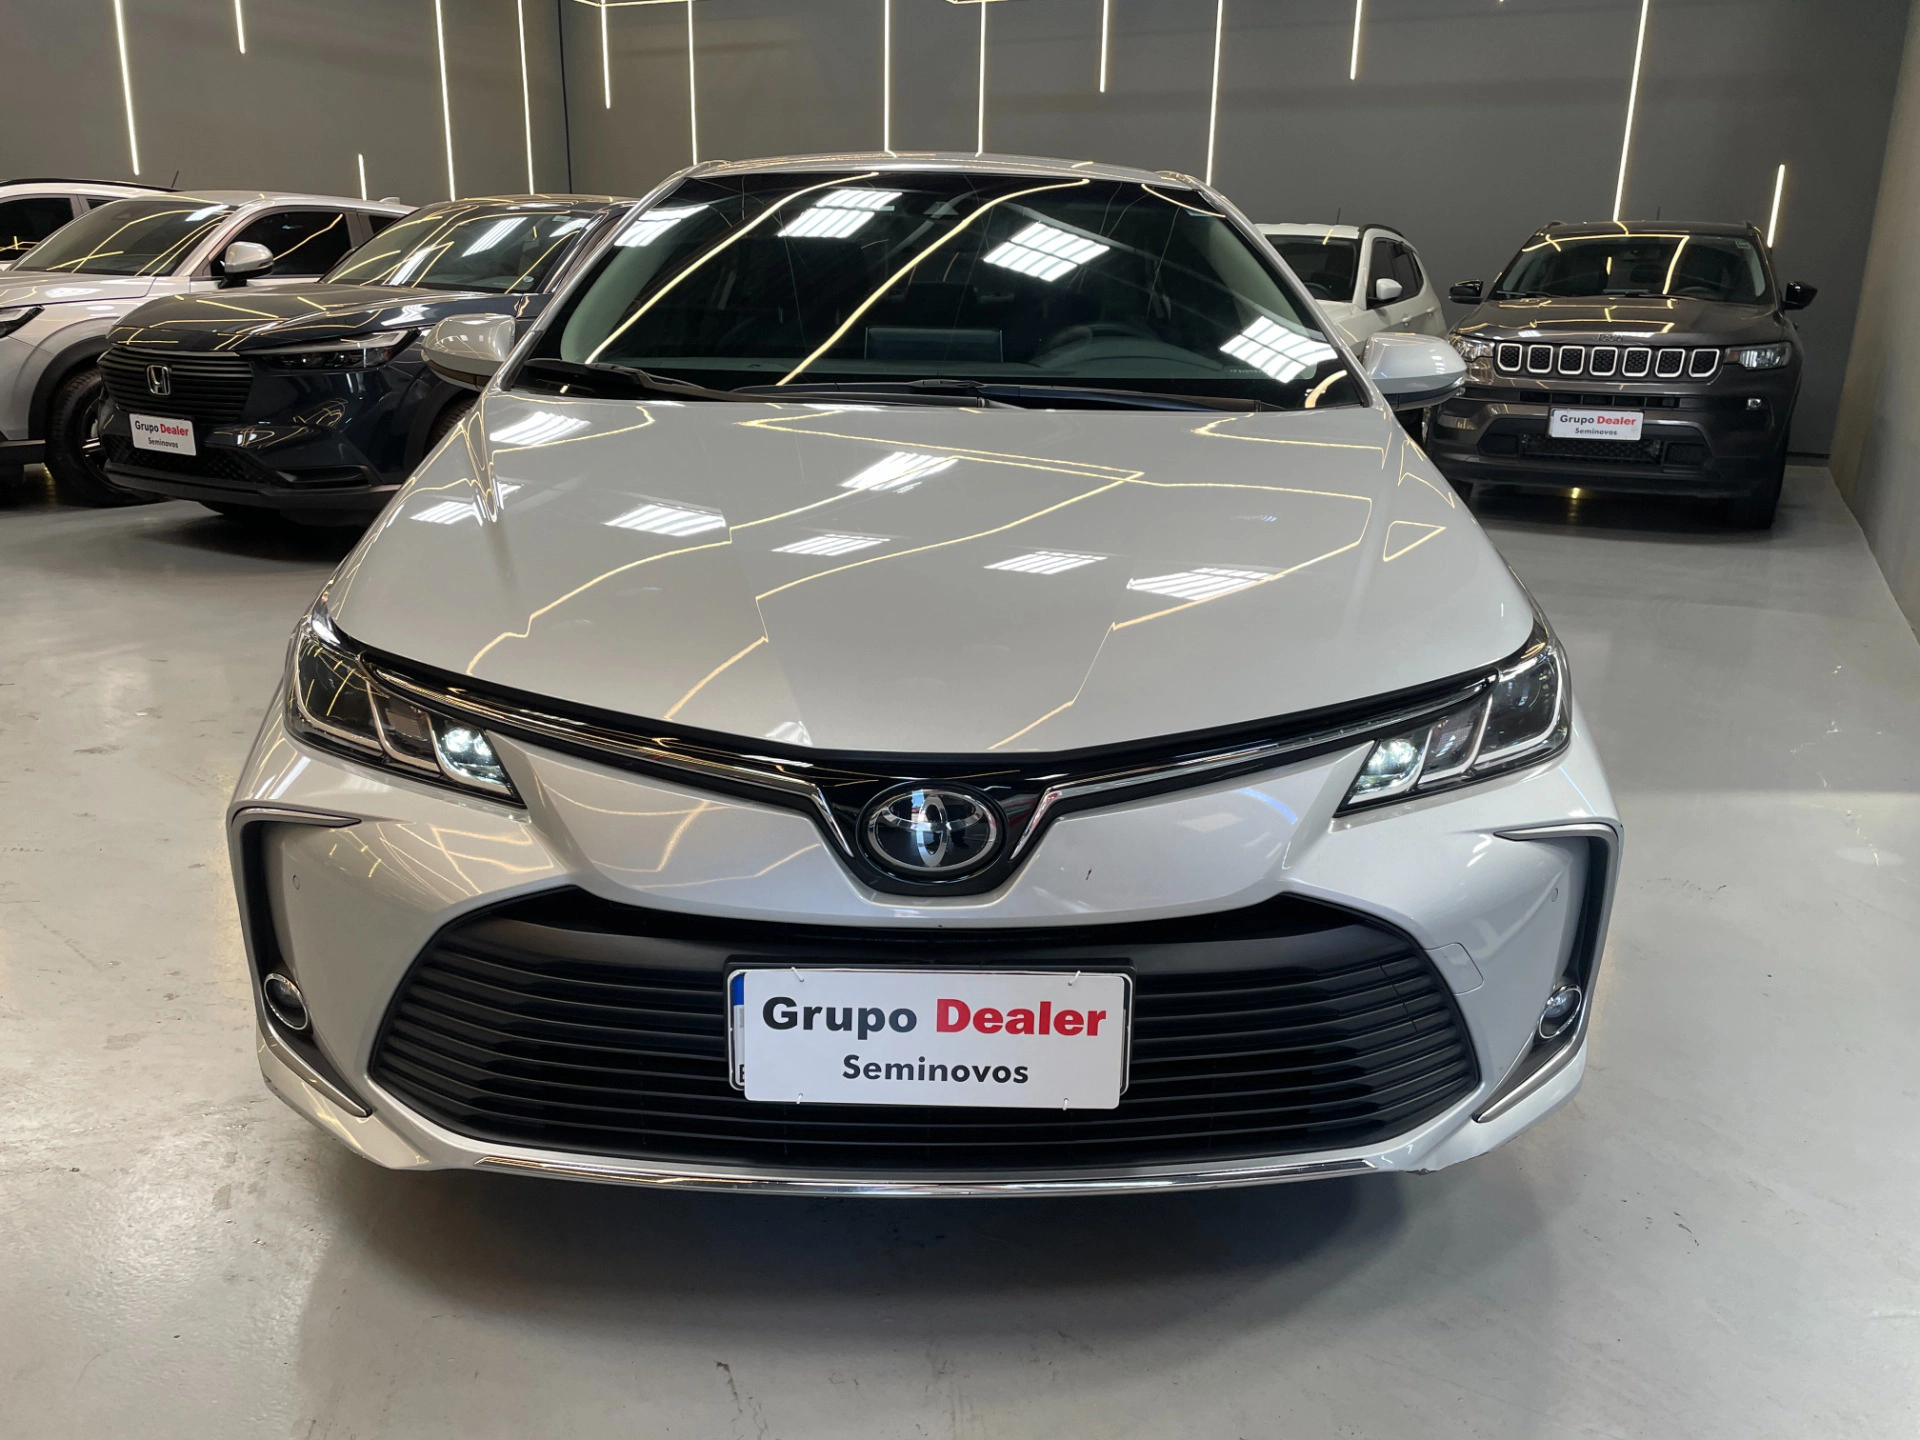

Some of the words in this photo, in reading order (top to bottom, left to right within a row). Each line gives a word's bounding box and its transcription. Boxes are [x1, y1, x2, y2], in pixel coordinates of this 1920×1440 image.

[135, 420, 159, 434] Grupo
[160, 423, 189, 436] Dealer
[1560, 414, 1595, 425] Grupo
[1597, 416, 1636, 426] Dealer
[148, 437, 179, 448] Seminovos
[762, 996, 918, 1040] Grupo
[936, 998, 1107, 1036] Dealer
[842, 1054, 1029, 1084] Seminovos
